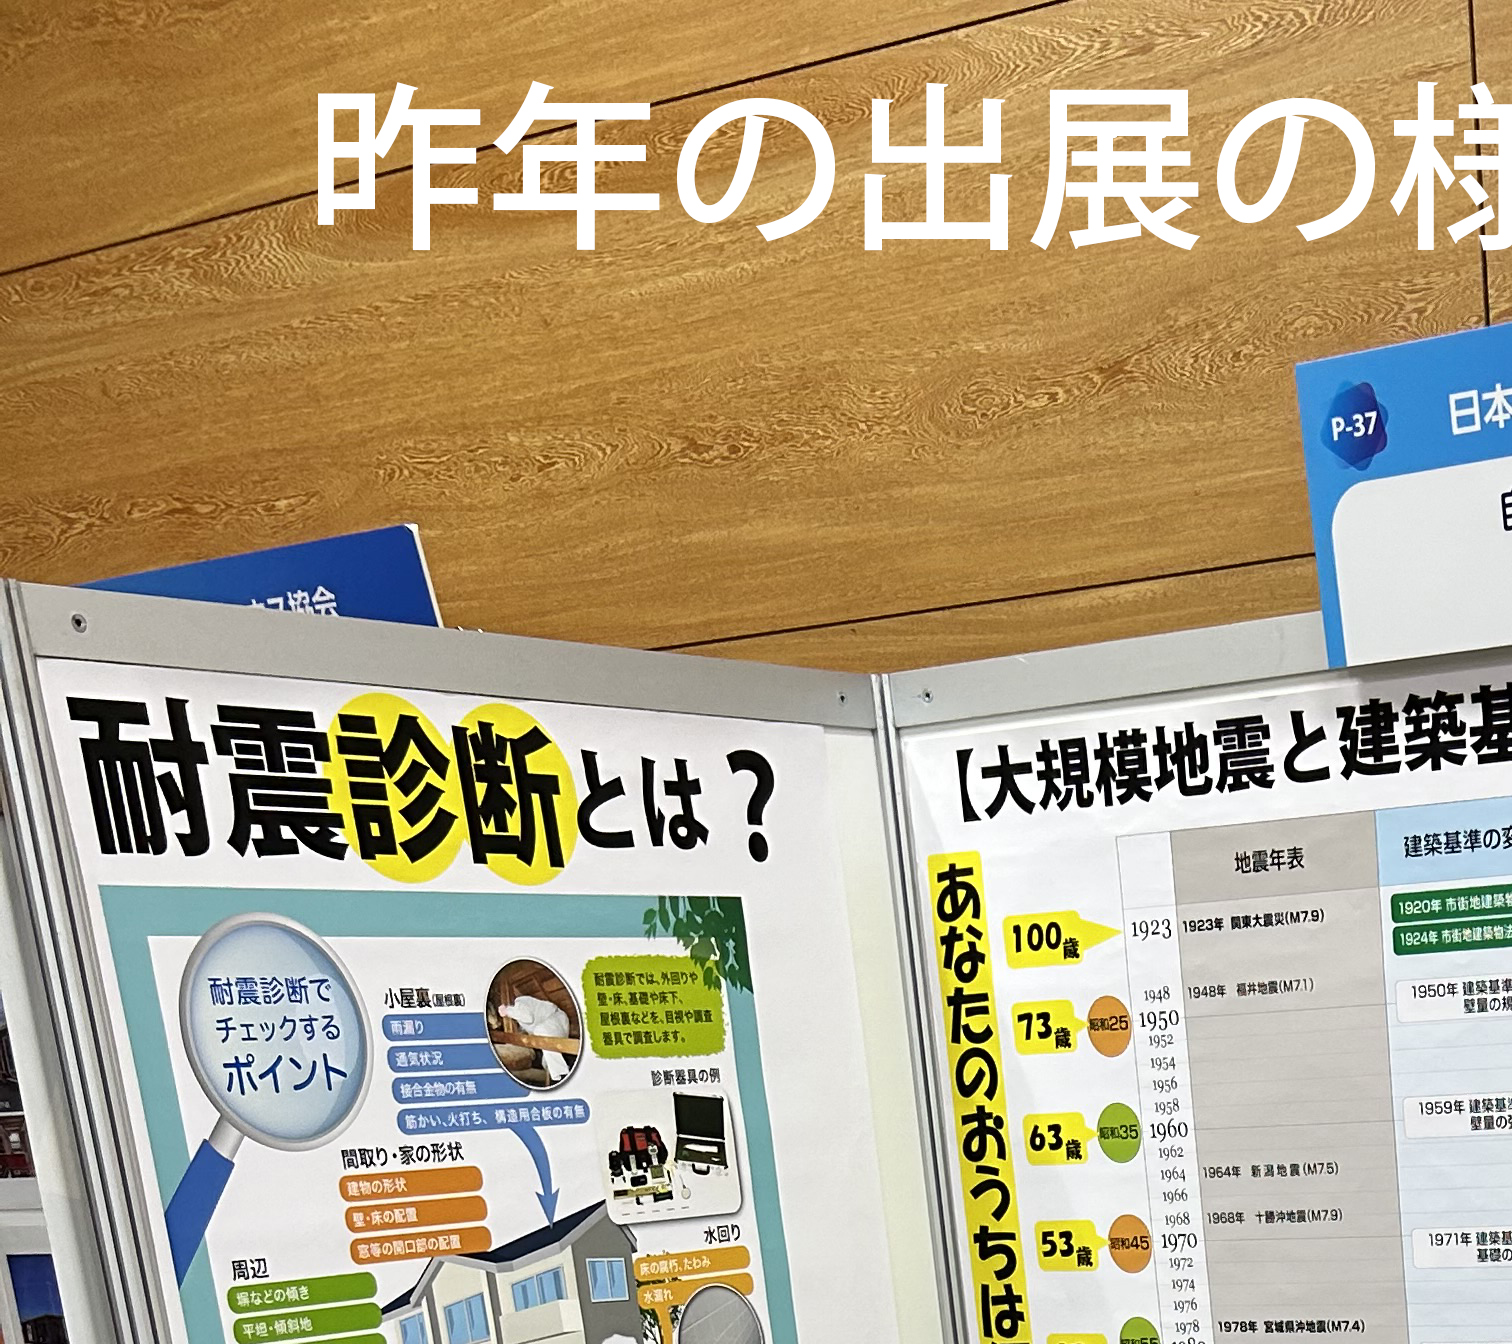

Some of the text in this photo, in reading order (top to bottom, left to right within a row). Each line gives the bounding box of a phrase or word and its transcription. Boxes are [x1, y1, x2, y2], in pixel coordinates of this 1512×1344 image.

[1330, 411, 1379, 442] P-37
[67, 693, 776, 867] 耐震診断とは？
[1234, 847, 1305, 874] 地震年表
[1131, 919, 1172, 940] 1923
[1182, 916, 1224, 933] 1923年
[1013, 922, 1080, 960] 100歳
[1400, 931, 1438, 945] 1924年
[208, 976, 331, 1006] 耐震診断で
[216, 1014, 341, 1043] チェックする
[390, 1019, 424, 1035] 雨漏り
[1089, 1017, 1129, 1031] 昭和25
[1148, 1034, 1174, 1048] 1952
[395, 1051, 444, 1066] 通気状況
[222, 1053, 348, 1096] ポイント
[651, 1067, 721, 1086] 診断器具の例
[400, 1080, 477, 1098] 接合金物の有無
[1154, 1099, 1180, 1114] 1958
[341, 1142, 464, 1170] 間取り・家の形状
[1160, 1168, 1186, 1181] 1964
[346, 1178, 407, 1194] 建物の形状
[1207, 1211, 1245, 1224] 1968年
[704, 1225, 741, 1243] 水回り
[1161, 1233, 1197, 1252] 1970
[1429, 1232, 1471, 1247] 1971年
[357, 1235, 460, 1258] 窓等の開口部の配置
[232, 1258, 269, 1281] 周辺
[1173, 1298, 1197, 1311] 1976
